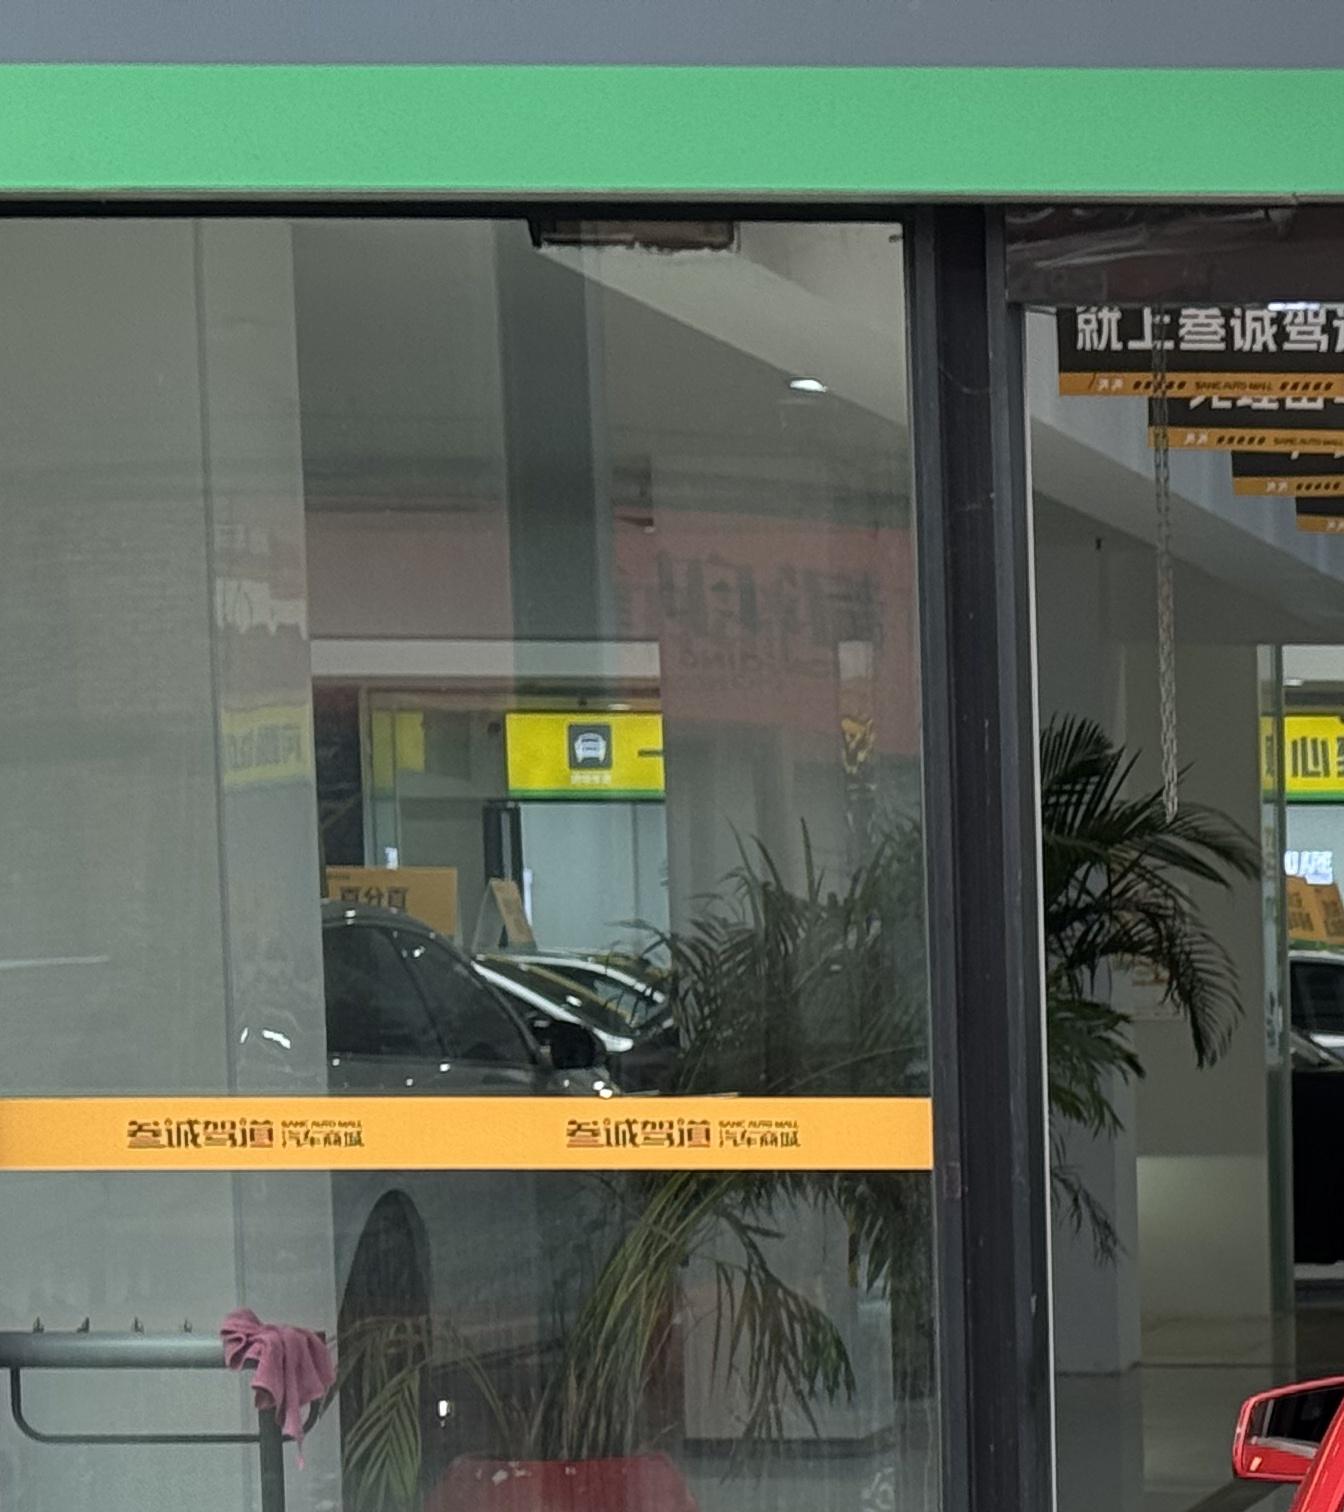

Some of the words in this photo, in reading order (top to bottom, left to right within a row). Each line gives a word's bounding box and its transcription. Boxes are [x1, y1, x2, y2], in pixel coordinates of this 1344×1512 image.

[127, 1118, 274, 1149] 叁诚驾道
[566, 1118, 711, 1148] 叁诚驾道
